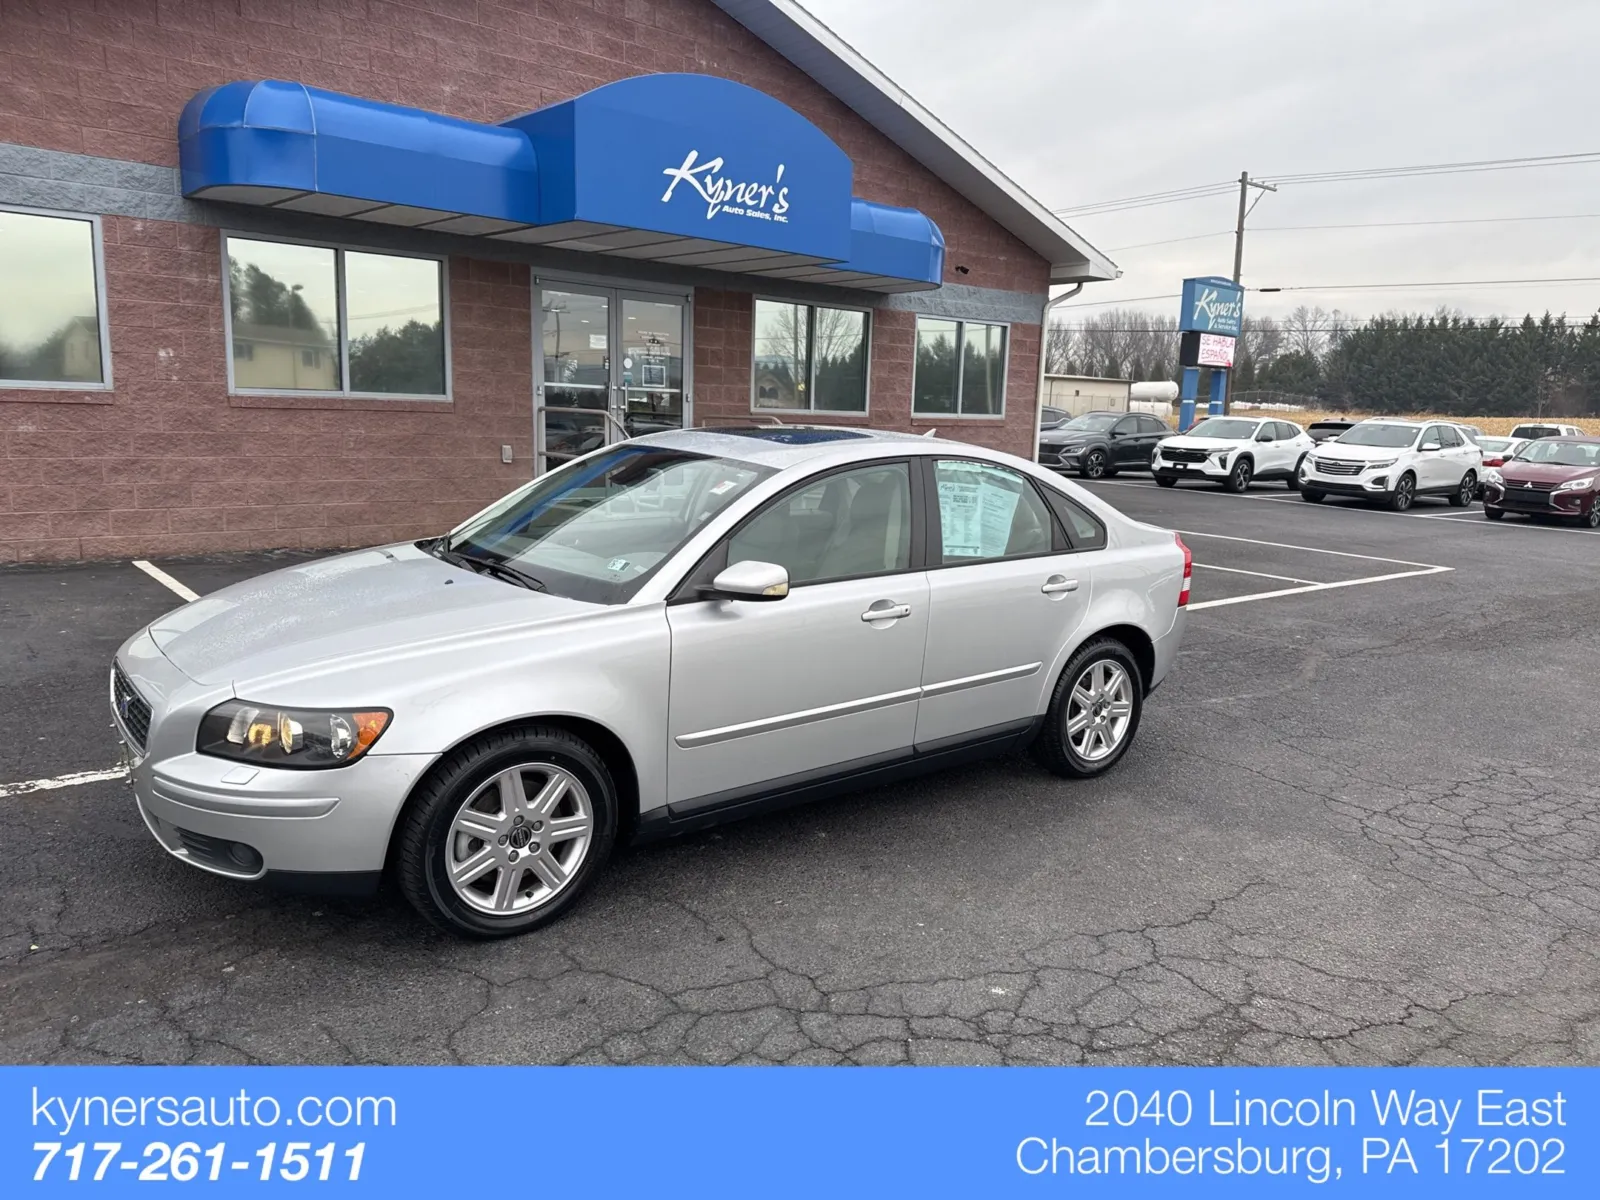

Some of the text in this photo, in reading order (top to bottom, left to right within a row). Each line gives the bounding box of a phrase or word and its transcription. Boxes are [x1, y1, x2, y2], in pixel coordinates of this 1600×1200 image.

[661, 149, 789, 220] Kyner's
[722, 205, 789, 223] Auto Sales, Inc.
[1193, 288, 1241, 330] Kyner's
[1201, 334, 1234, 349] SE HABLA
